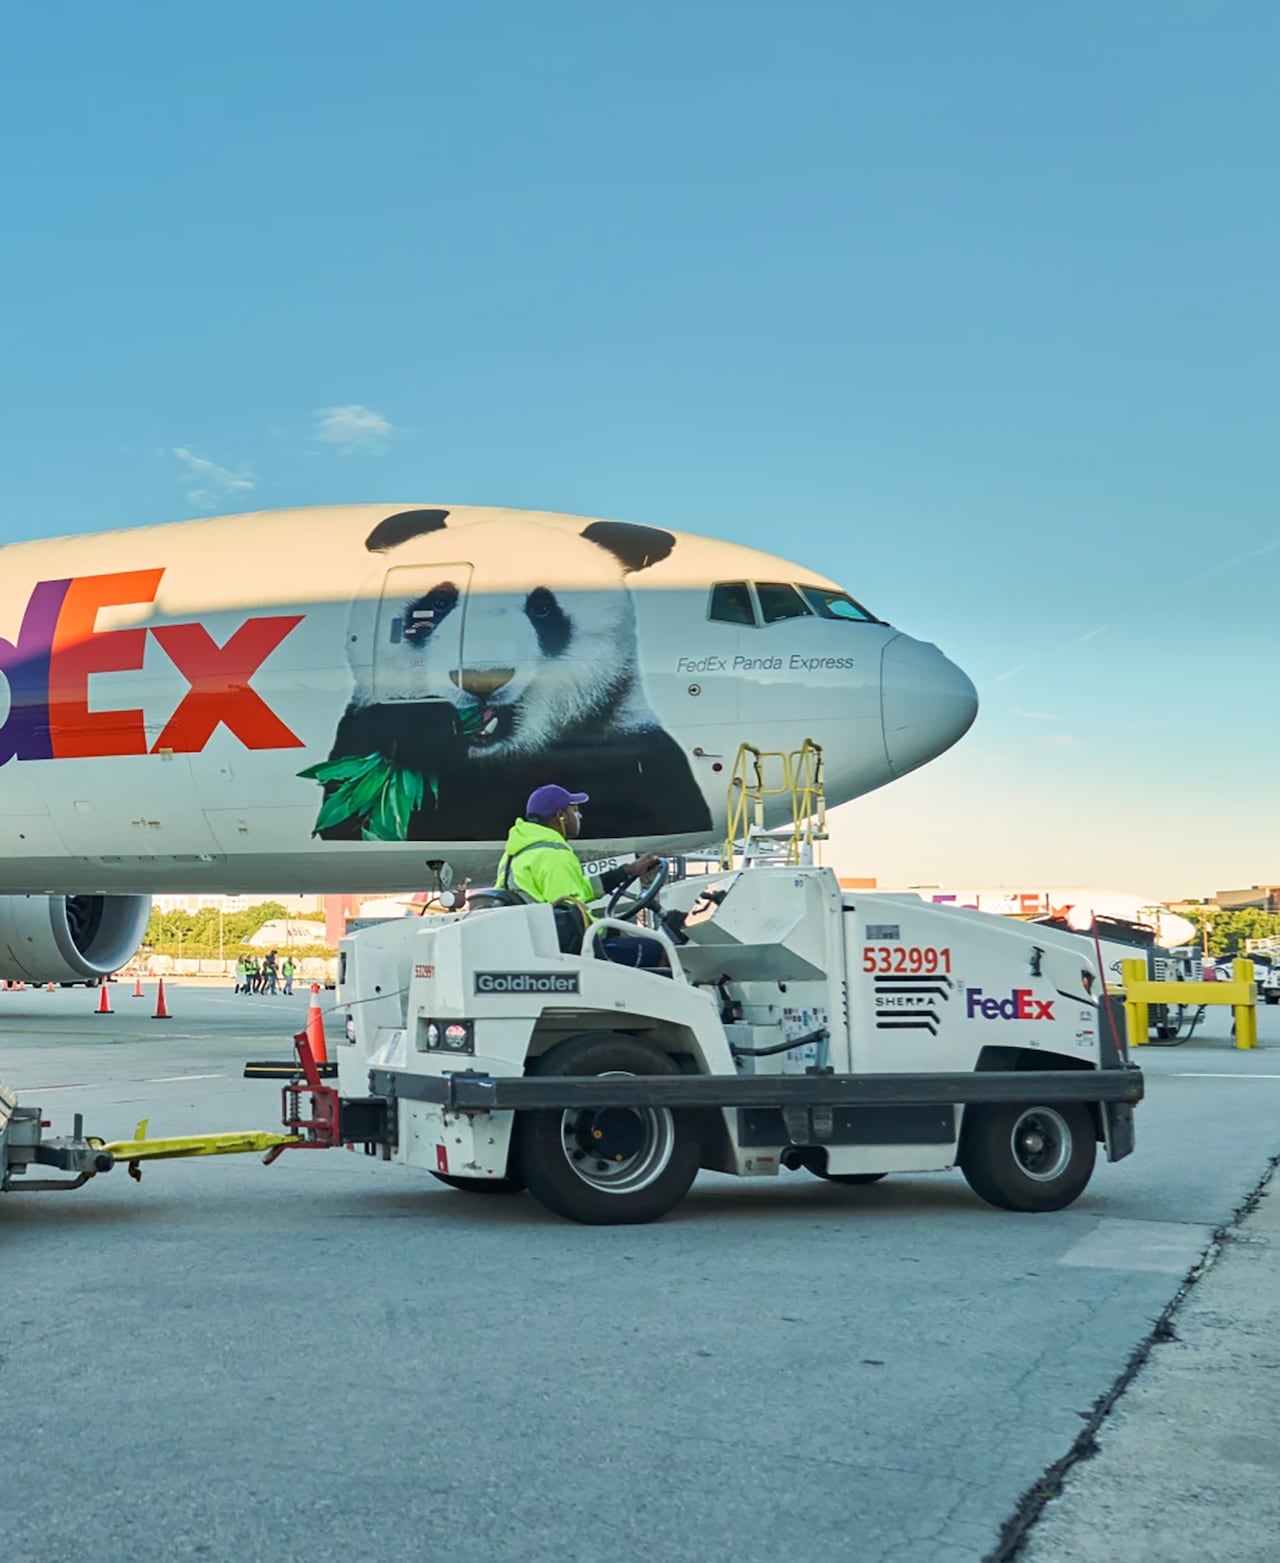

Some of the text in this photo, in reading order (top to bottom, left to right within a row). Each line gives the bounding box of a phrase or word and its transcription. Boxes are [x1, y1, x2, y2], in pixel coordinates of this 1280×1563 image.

[677, 654, 854, 673] FedEx Panda Express
[863, 947, 951, 973] 532991
[478, 975, 576, 991] Goldhofer
[875, 997, 936, 1006] SHERPA
[967, 988, 1055, 1020] FedEx
